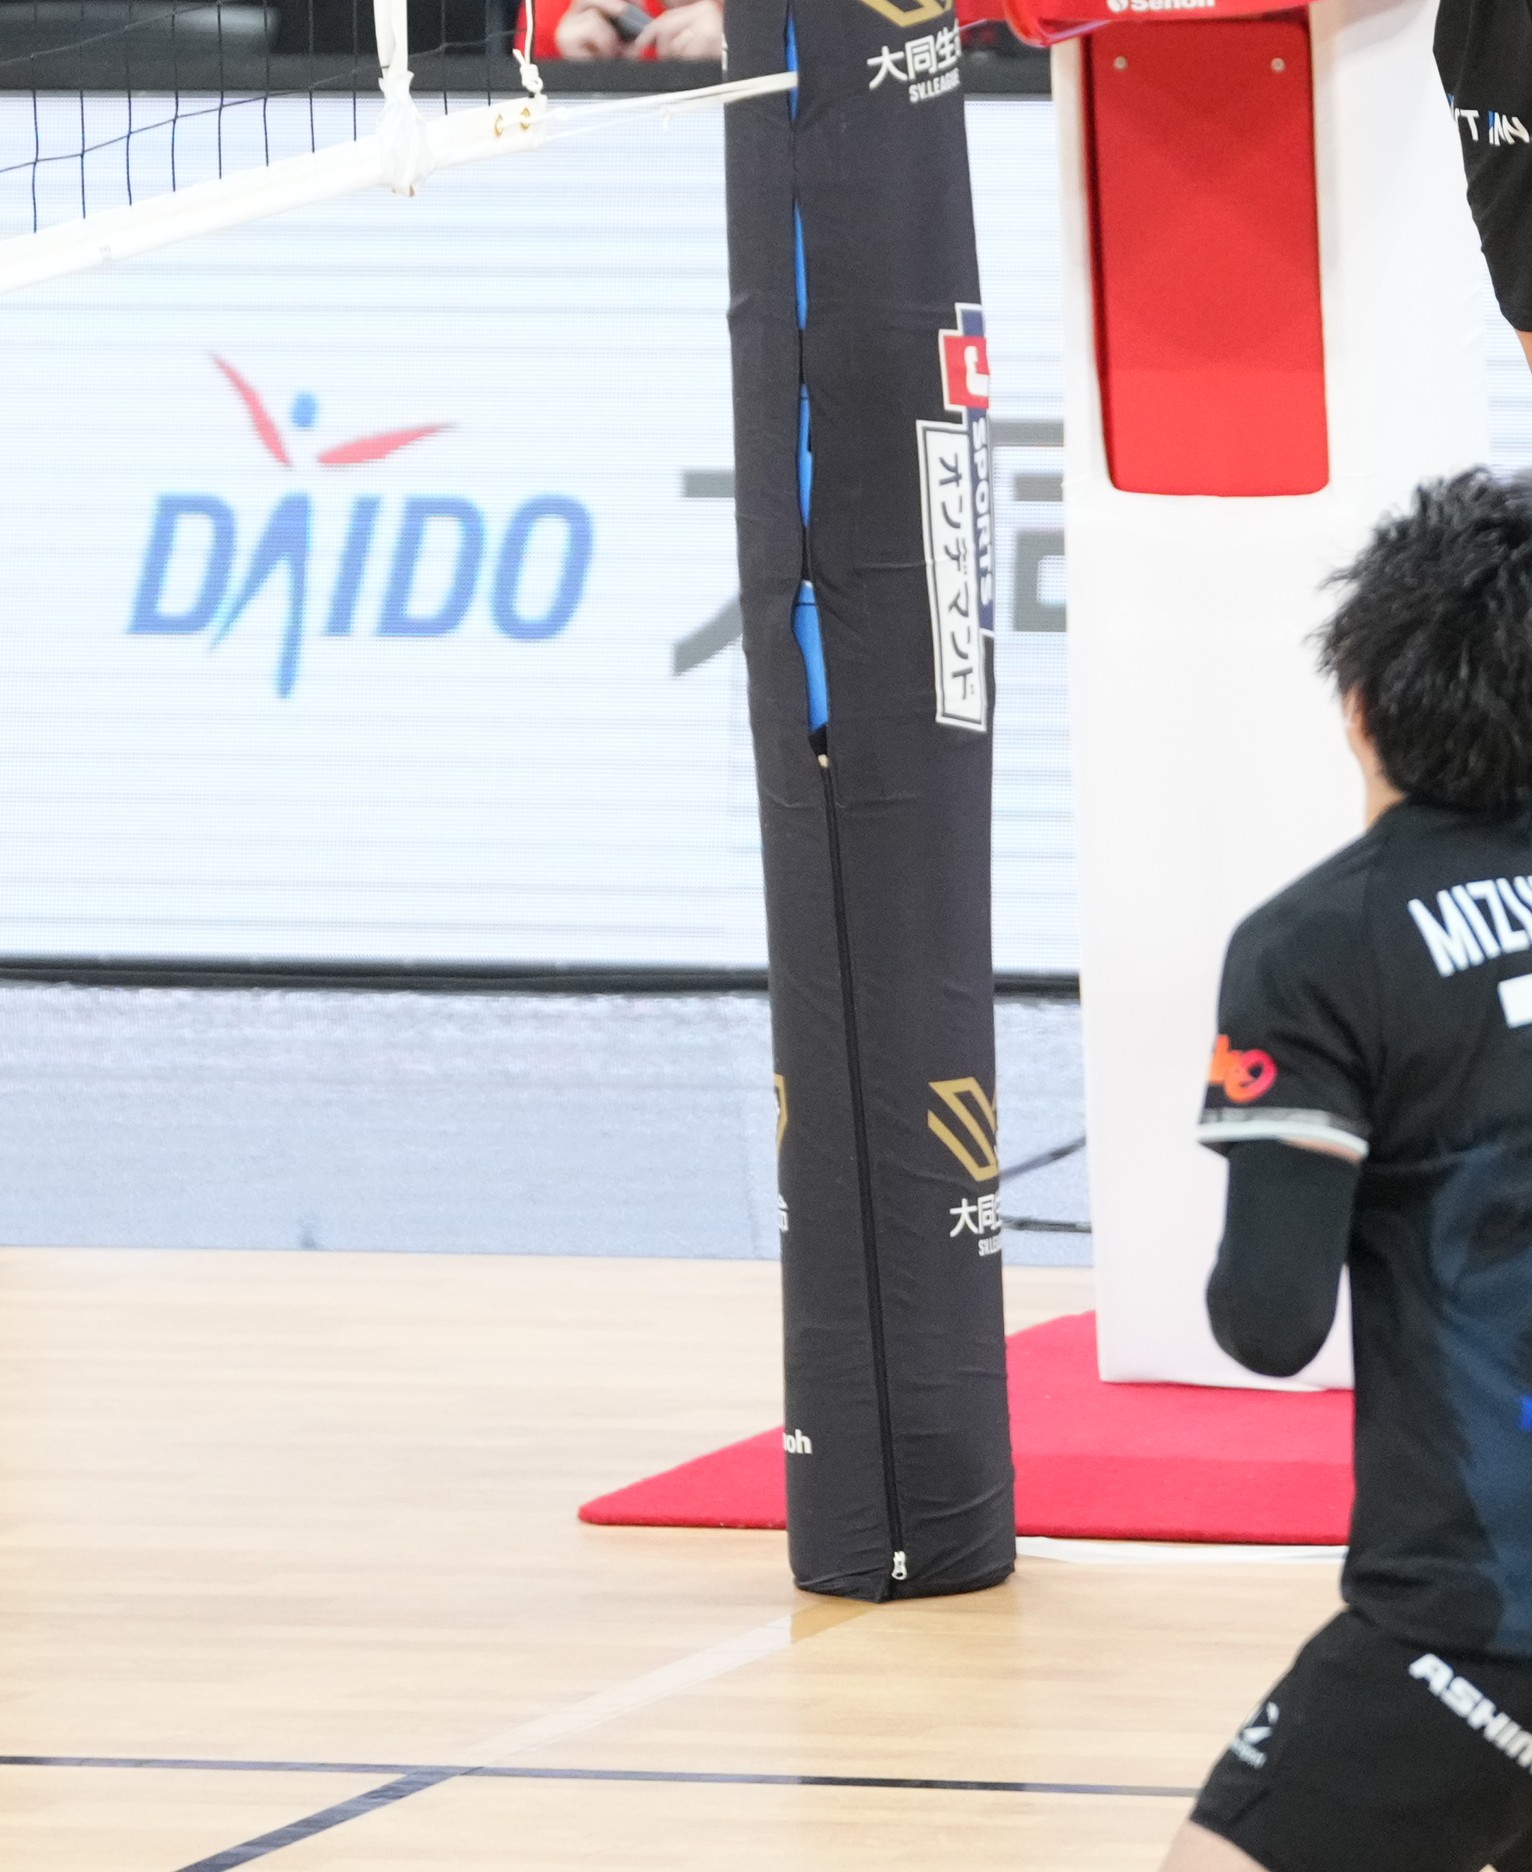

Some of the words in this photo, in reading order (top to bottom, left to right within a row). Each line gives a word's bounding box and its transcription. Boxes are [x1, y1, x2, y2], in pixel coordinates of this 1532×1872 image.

[866, 18, 962, 90] 大同生
[126, 490, 594, 699] DAIDO
[938, 451, 979, 703] オンデマンド
